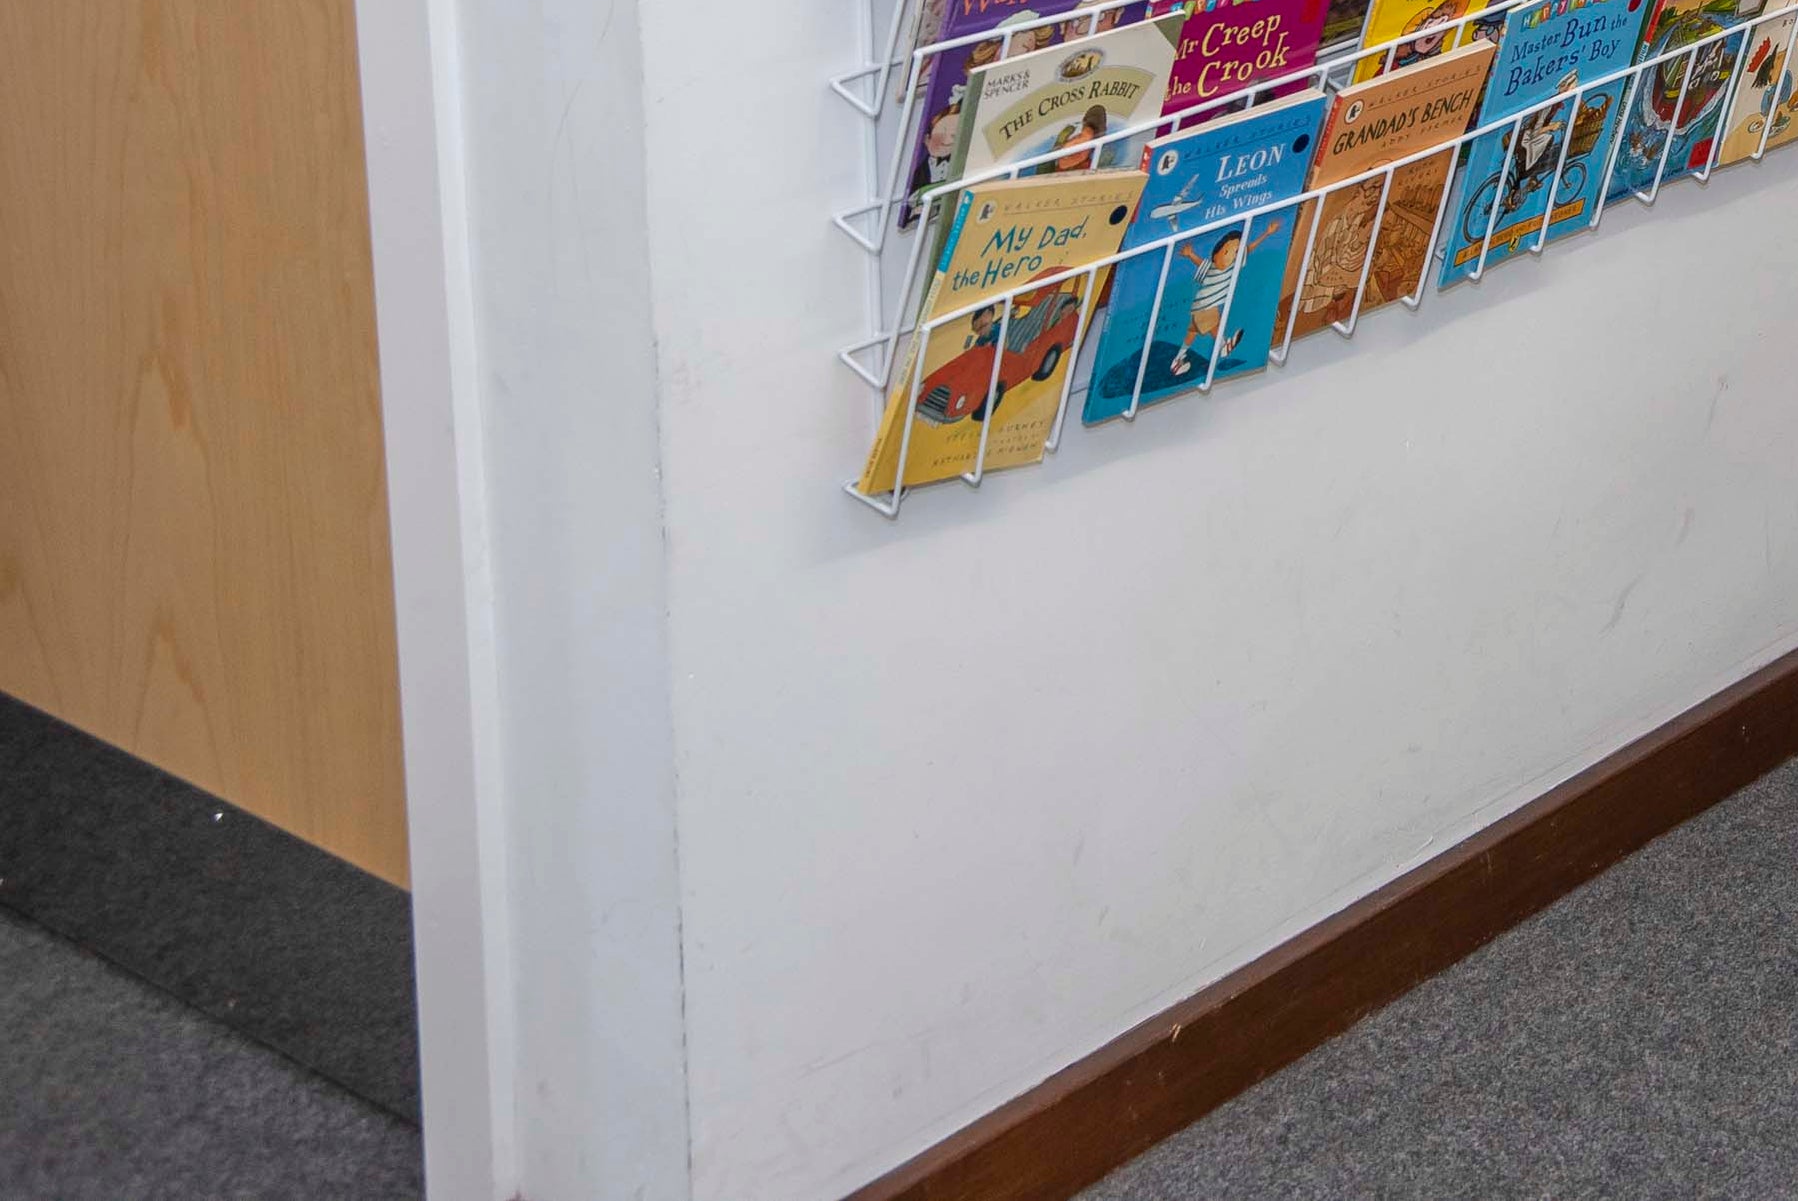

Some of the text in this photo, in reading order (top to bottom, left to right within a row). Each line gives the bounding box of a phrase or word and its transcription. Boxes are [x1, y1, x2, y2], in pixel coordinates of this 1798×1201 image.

[1201, 15, 1281, 56] Creep
[1511, 14, 1628, 64] Master Bun the
[1588, 38, 1622, 62] Boy
[1197, 31, 1290, 98] Crook
[999, 81, 1140, 141] THE CROSS RABBIT
[1333, 89, 1474, 155] GRANDAD'S BENCH
[1215, 143, 1286, 183] LEON
[1205, 191, 1272, 220] His Wings
[1220, 174, 1268, 199] Spreads
[980, 216, 1089, 258] My Dad,
[952, 255, 1043, 291] the Hero
